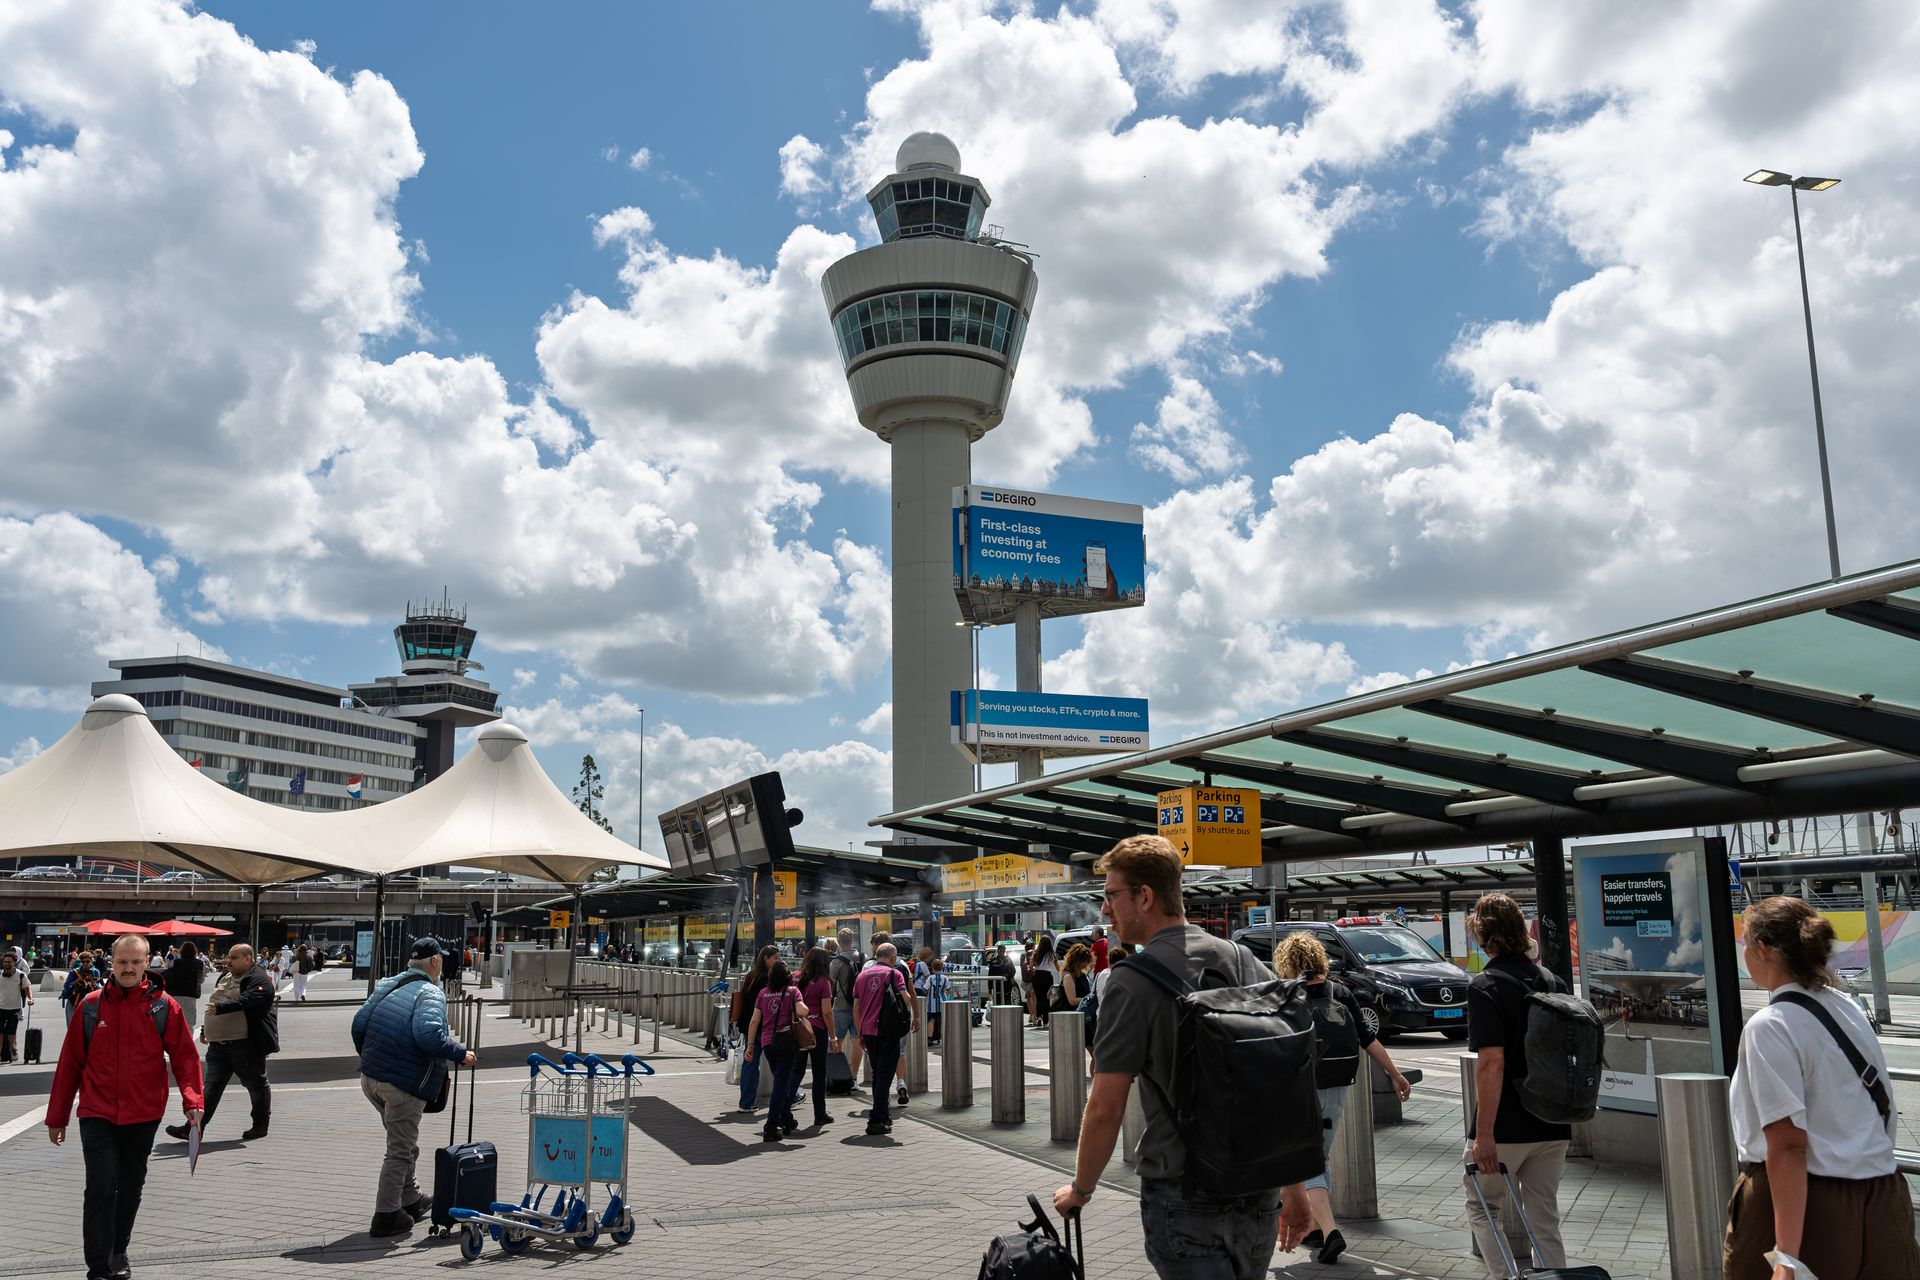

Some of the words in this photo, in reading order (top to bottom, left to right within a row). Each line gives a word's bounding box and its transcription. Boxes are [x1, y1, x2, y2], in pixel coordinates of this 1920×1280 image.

[995, 493, 1036, 506] DEGIRO
[980, 518, 1041, 535] First-class
[981, 532, 1033, 549] investing
[1035, 538, 1047, 549] at
[981, 549, 1033, 564] economy
[1035, 552, 1060, 564] fees
[979, 701, 1011, 713] Serving
[1011, 705, 1027, 713] you
[1028, 705, 1058, 715] stocks,
[1059, 707, 1082, 716] ETFs,
[1083, 708, 1109, 718] crypto
[1110, 709, 1116, 717] &
[979, 729, 996, 738] This
[996, 730, 1004, 739] is
[1005, 731, 1018, 740] not
[1019, 731, 1062, 742] investment
[1063, 733, 1090, 743] advice.
[1109, 736, 1141, 745] DEGIRO
[1160, 793, 1182, 805] Parking
[1196, 790, 1241, 804] Parking
[1198, 807, 1213, 821] P3
[1224, 808, 1239, 822] P4
[1197, 826, 1206, 834] By
[1208, 826, 1235, 835] shuttle
[1237, 827, 1250, 835] bus
[1603, 879, 1627, 890] Easier
[1627, 877, 1666, 889] transfers,
[1604, 892, 1633, 904] happier
[1635, 890, 1663, 902] travels
[563, 1149, 576, 1161] TUI
[598, 1146, 612, 1157] TUI
